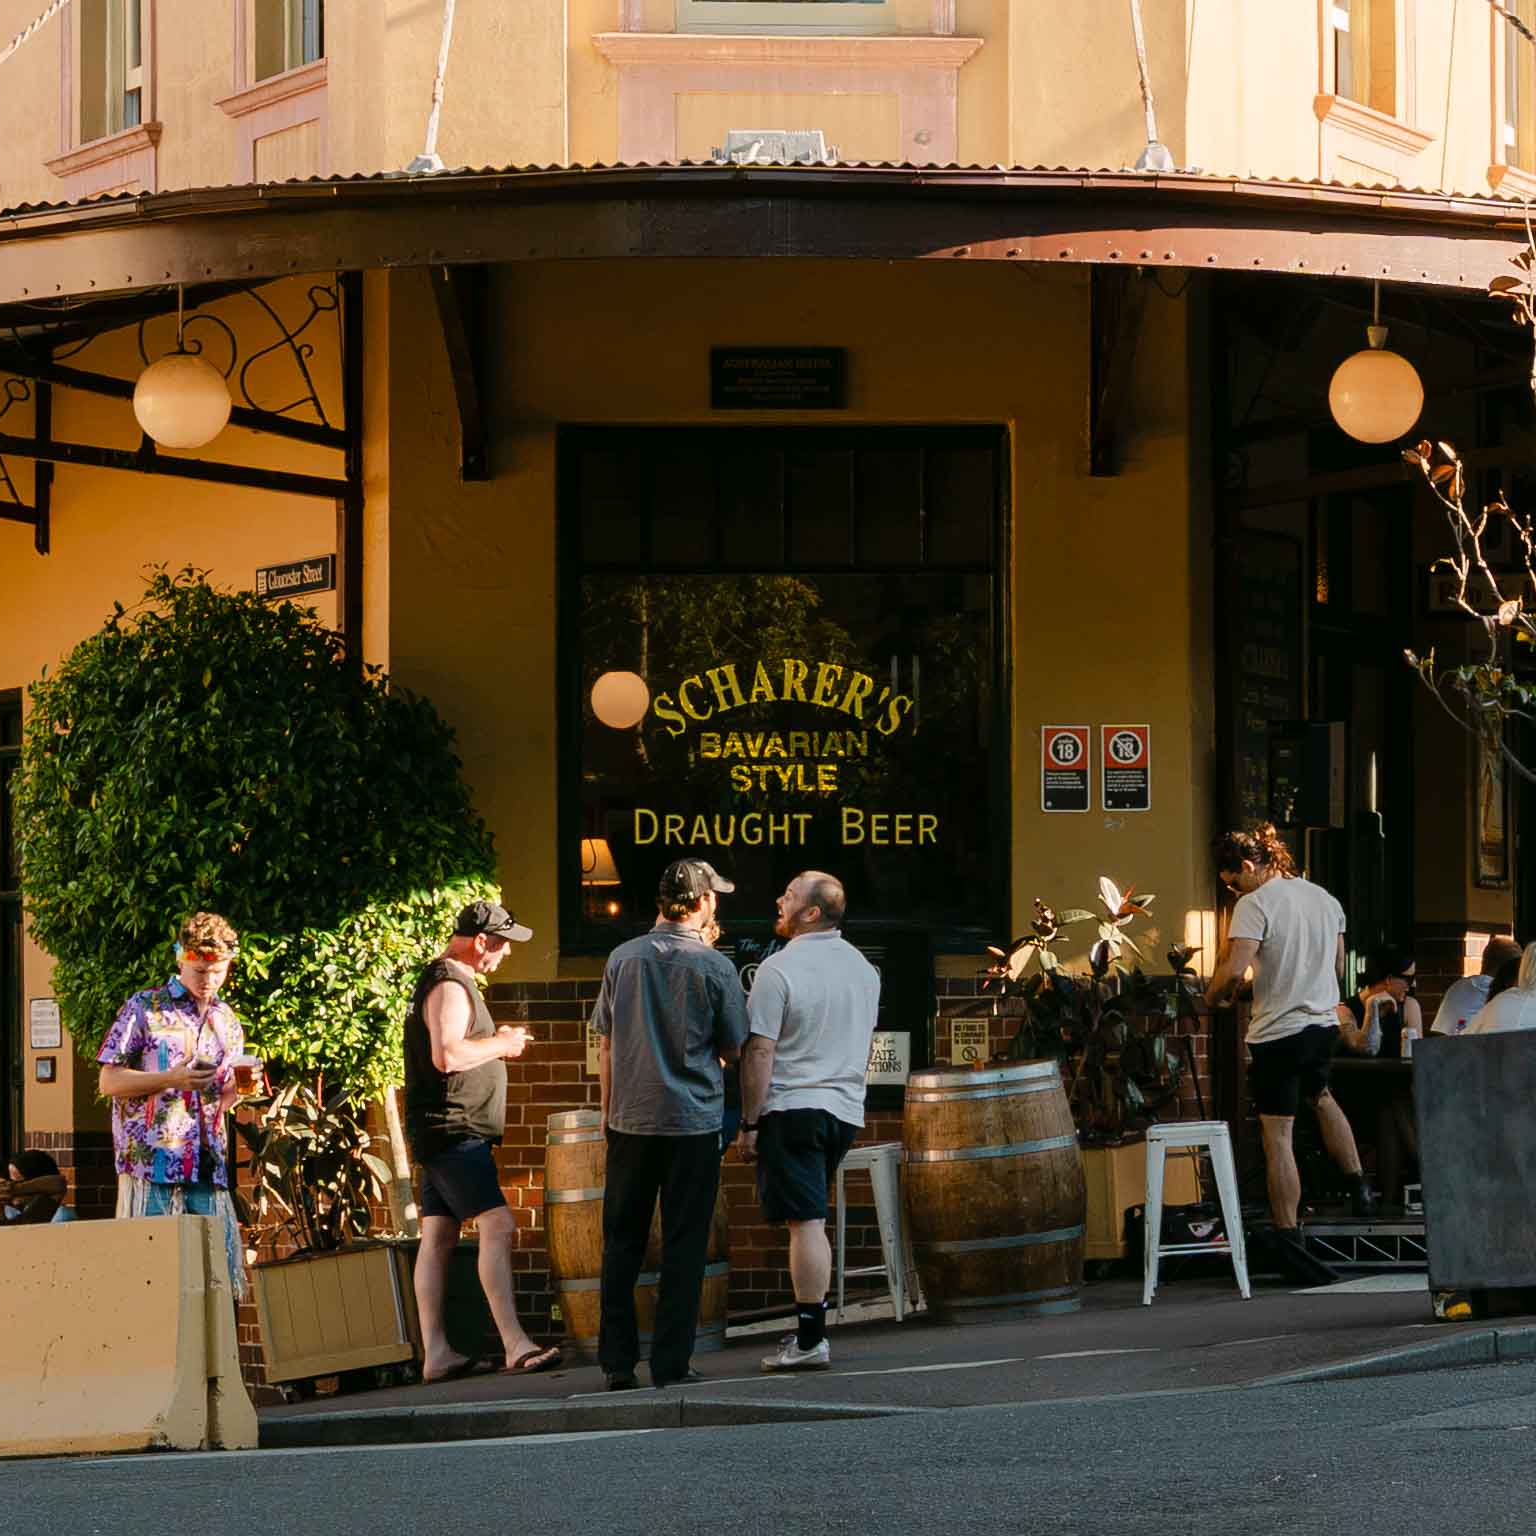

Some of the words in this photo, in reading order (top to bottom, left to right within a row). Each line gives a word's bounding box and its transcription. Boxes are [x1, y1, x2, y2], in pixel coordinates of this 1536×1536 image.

[653, 658, 914, 738] SCHARER'S
[699, 730, 869, 759] BAVARIAN
[1057, 744, 1075, 760] 18
[729, 763, 839, 793] STYLE
[633, 807, 813, 847] DRAUGHT
[841, 806, 939, 846] BEER
